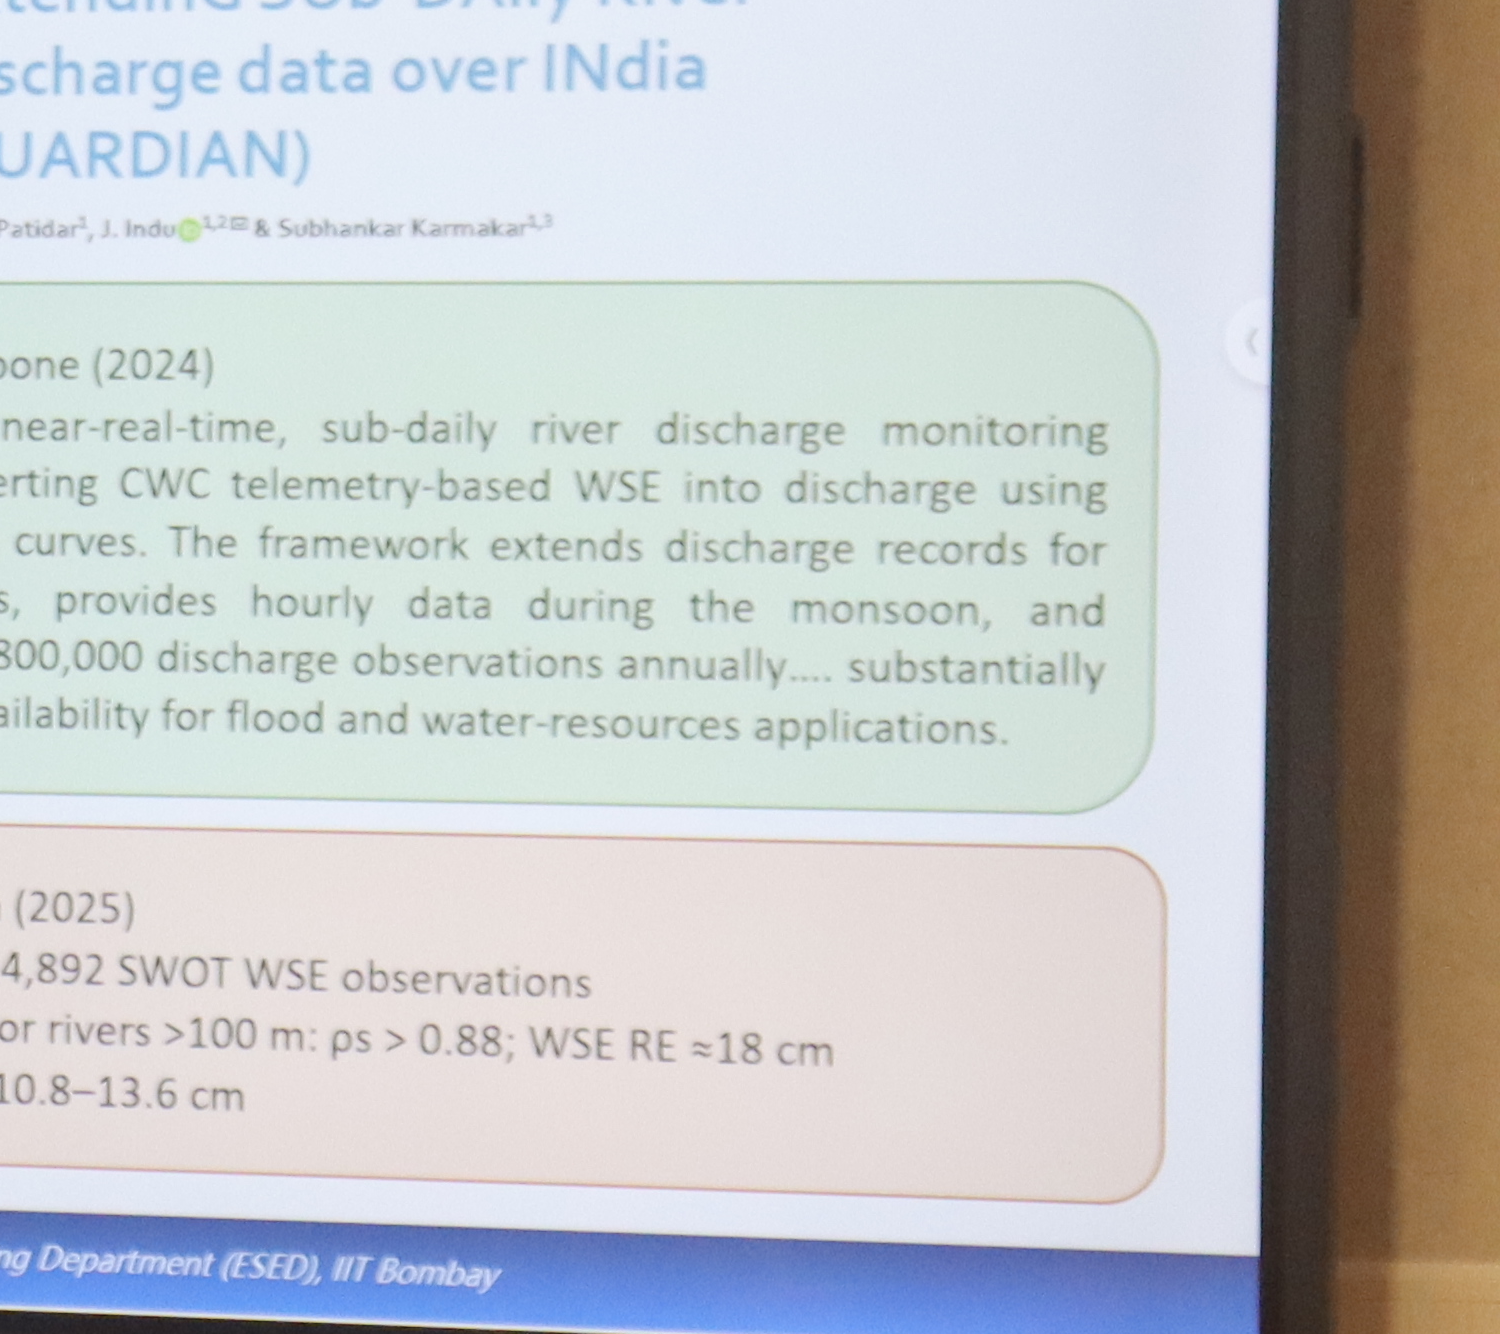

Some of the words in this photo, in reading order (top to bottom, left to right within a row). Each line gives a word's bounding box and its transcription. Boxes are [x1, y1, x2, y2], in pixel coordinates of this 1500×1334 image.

[237, 42, 373, 96] data
[391, 56, 528, 95] over
[544, 39, 708, 93] INdia
[92, 346, 214, 387] (2024)
[2, 408, 286, 450] near-real-time,
[322, 409, 498, 453] sub-daily
[531, 412, 622, 446] river
[655, 411, 846, 456] discharge
[882, 415, 1110, 458] monitoring
[14, 888, 135, 933] (2025)
[117, 953, 232, 989] SWOT
[243, 957, 328, 993] WSE
[340, 959, 592, 1000] observations
[40, 1242, 214, 1279] Department
[219, 1249, 321, 1287] (ESED),
[331, 1253, 373, 1281] IIT
[377, 1255, 503, 1296] Bombay
